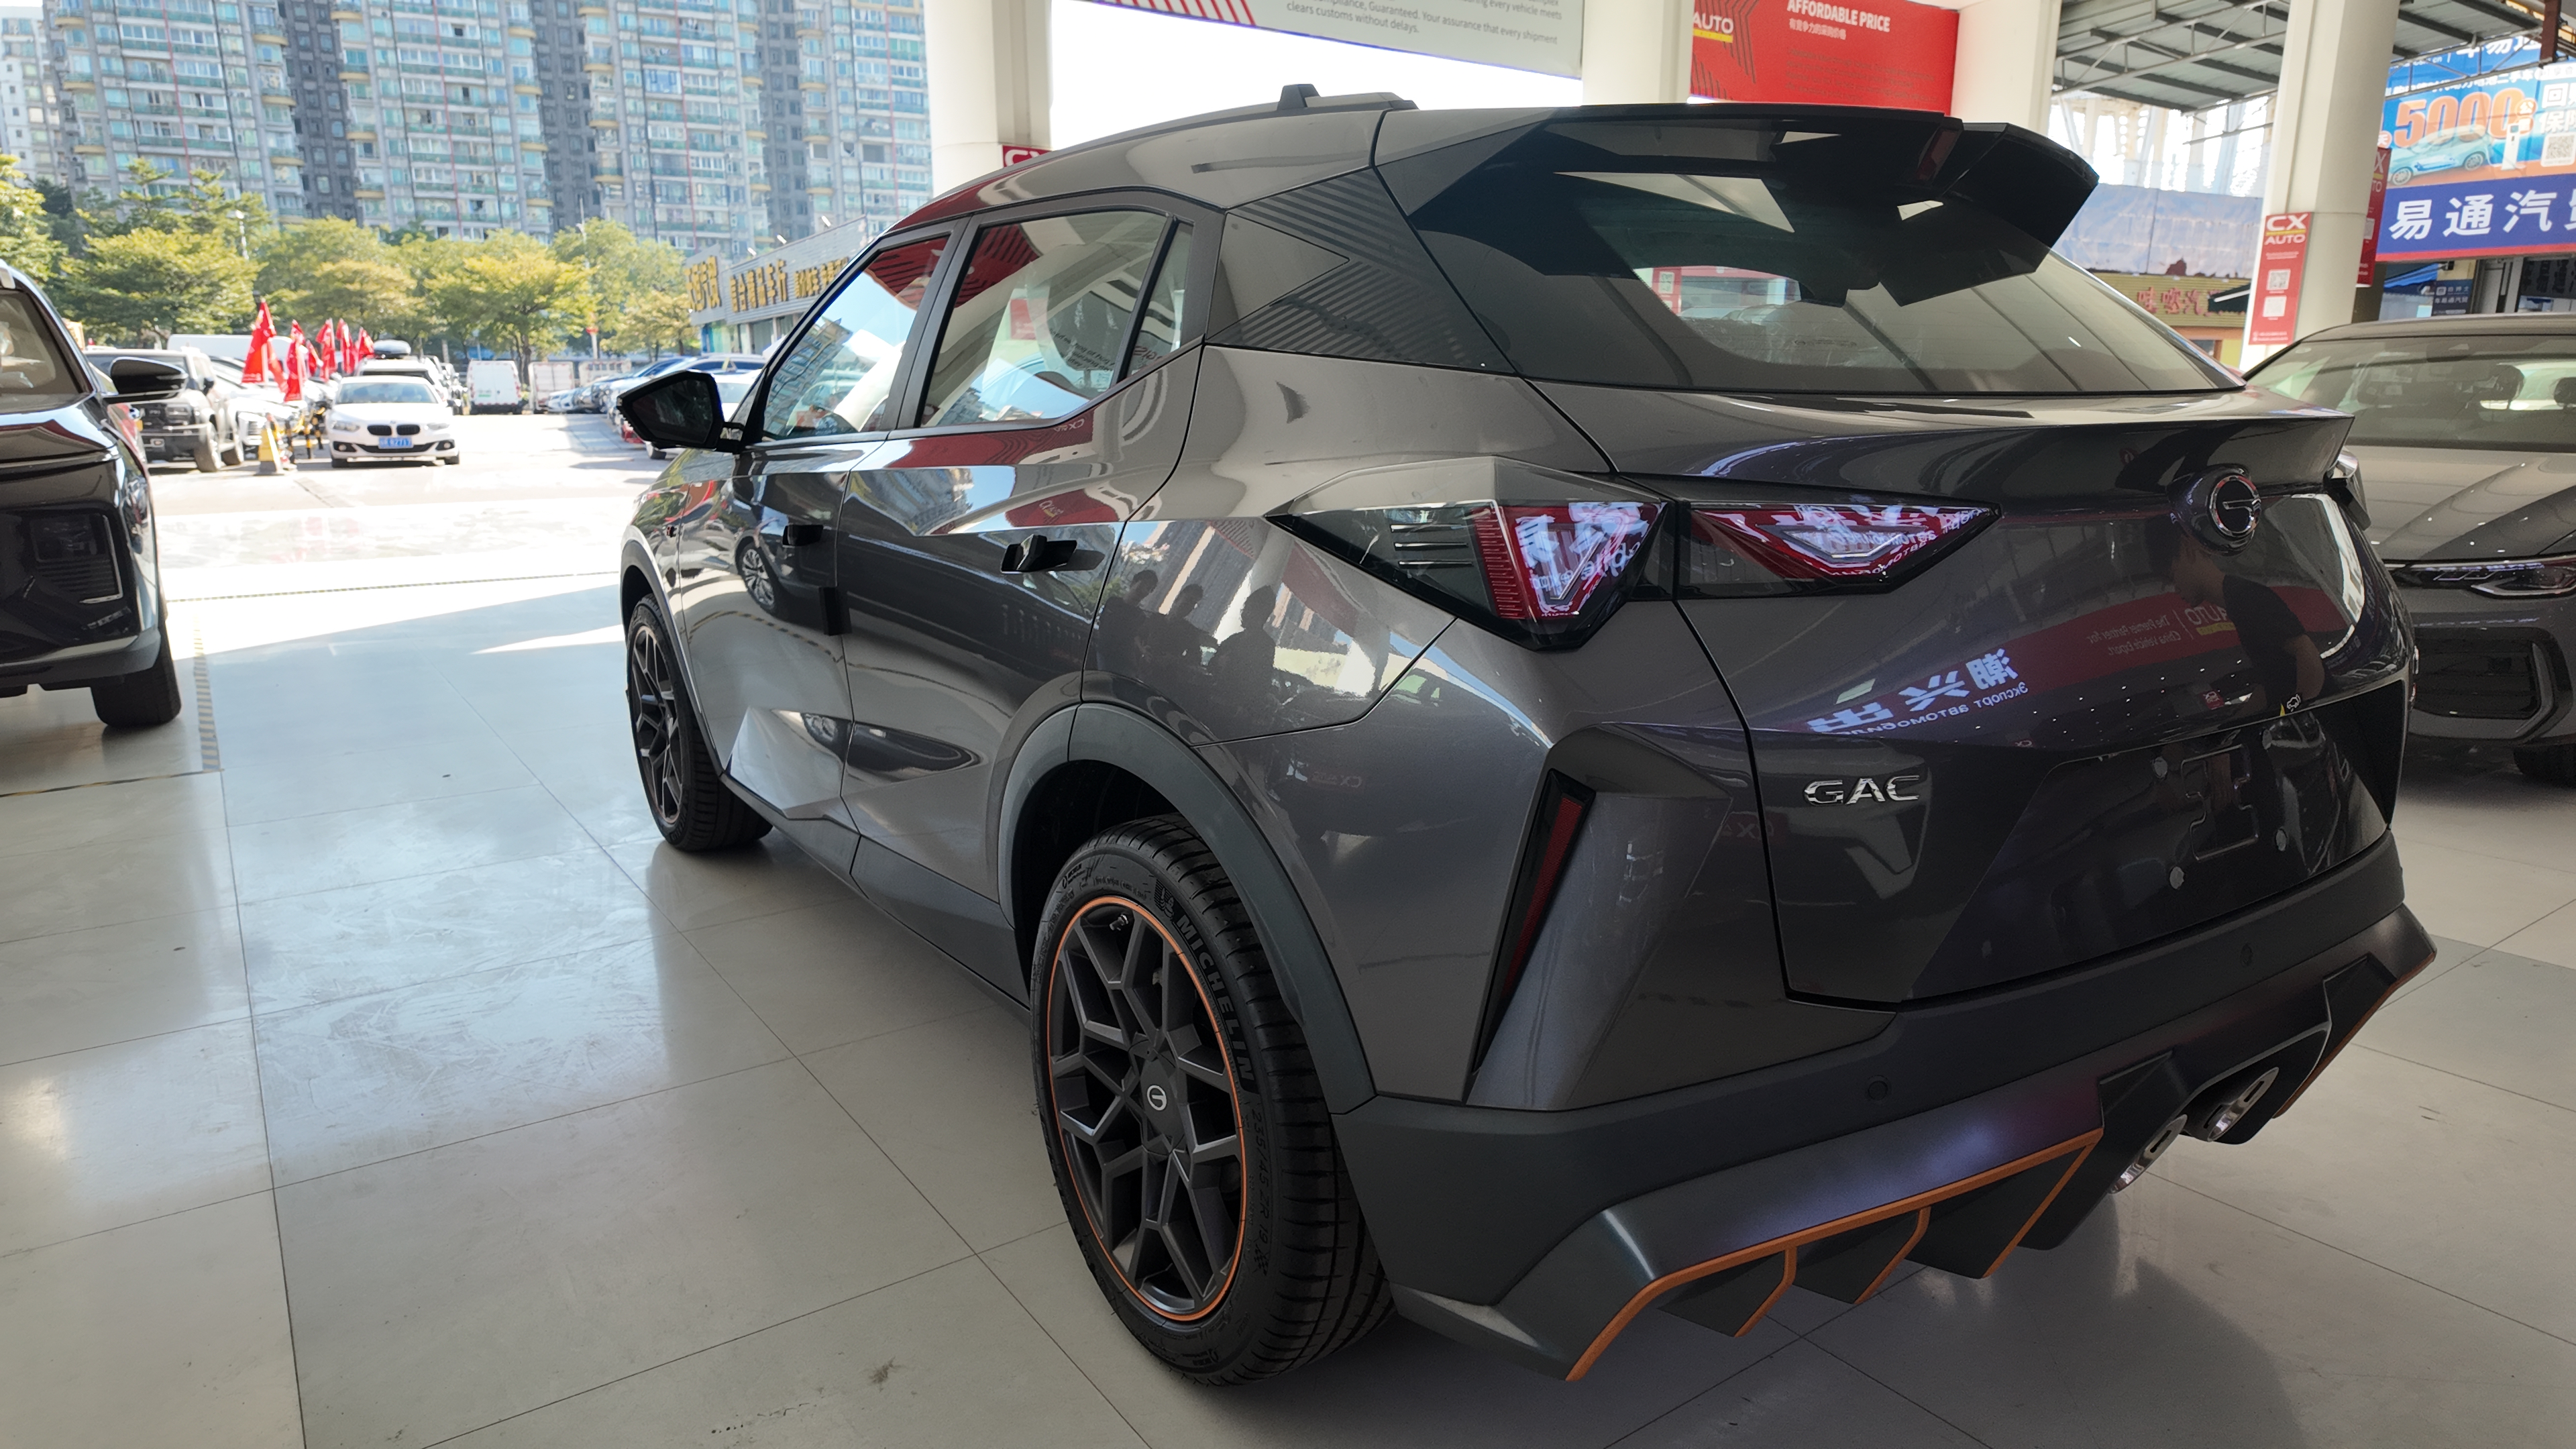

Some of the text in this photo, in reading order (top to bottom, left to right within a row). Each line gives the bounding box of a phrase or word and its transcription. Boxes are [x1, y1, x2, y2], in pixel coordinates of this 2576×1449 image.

[1287, 1, 1419, 34] clears customs without delays.
[1368, 1, 1420, 19] Guaranteed.
[1421, 11, 1441, 23] Your
[1442, 17, 1482, 31] assurance
[1483, 22, 1499, 34] that
[1500, 28, 1521, 40] every
[1522, 30, 1558, 45] shipment
[1512, 2, 1538, 15] vehicle
[1540, 8, 1562, 20] meets
[1693, 11, 1734, 34] AUTO
[1786, 0, 1891, 33] AFFORDABLE PRICE
[2394, 88, 2525, 148] 5000
[2266, 213, 2308, 231] CX
[2264, 234, 2306, 246] AUTO
[1804, 774, 1920, 806] GAC
[1177, 914, 1254, 1081] MICHELIN
